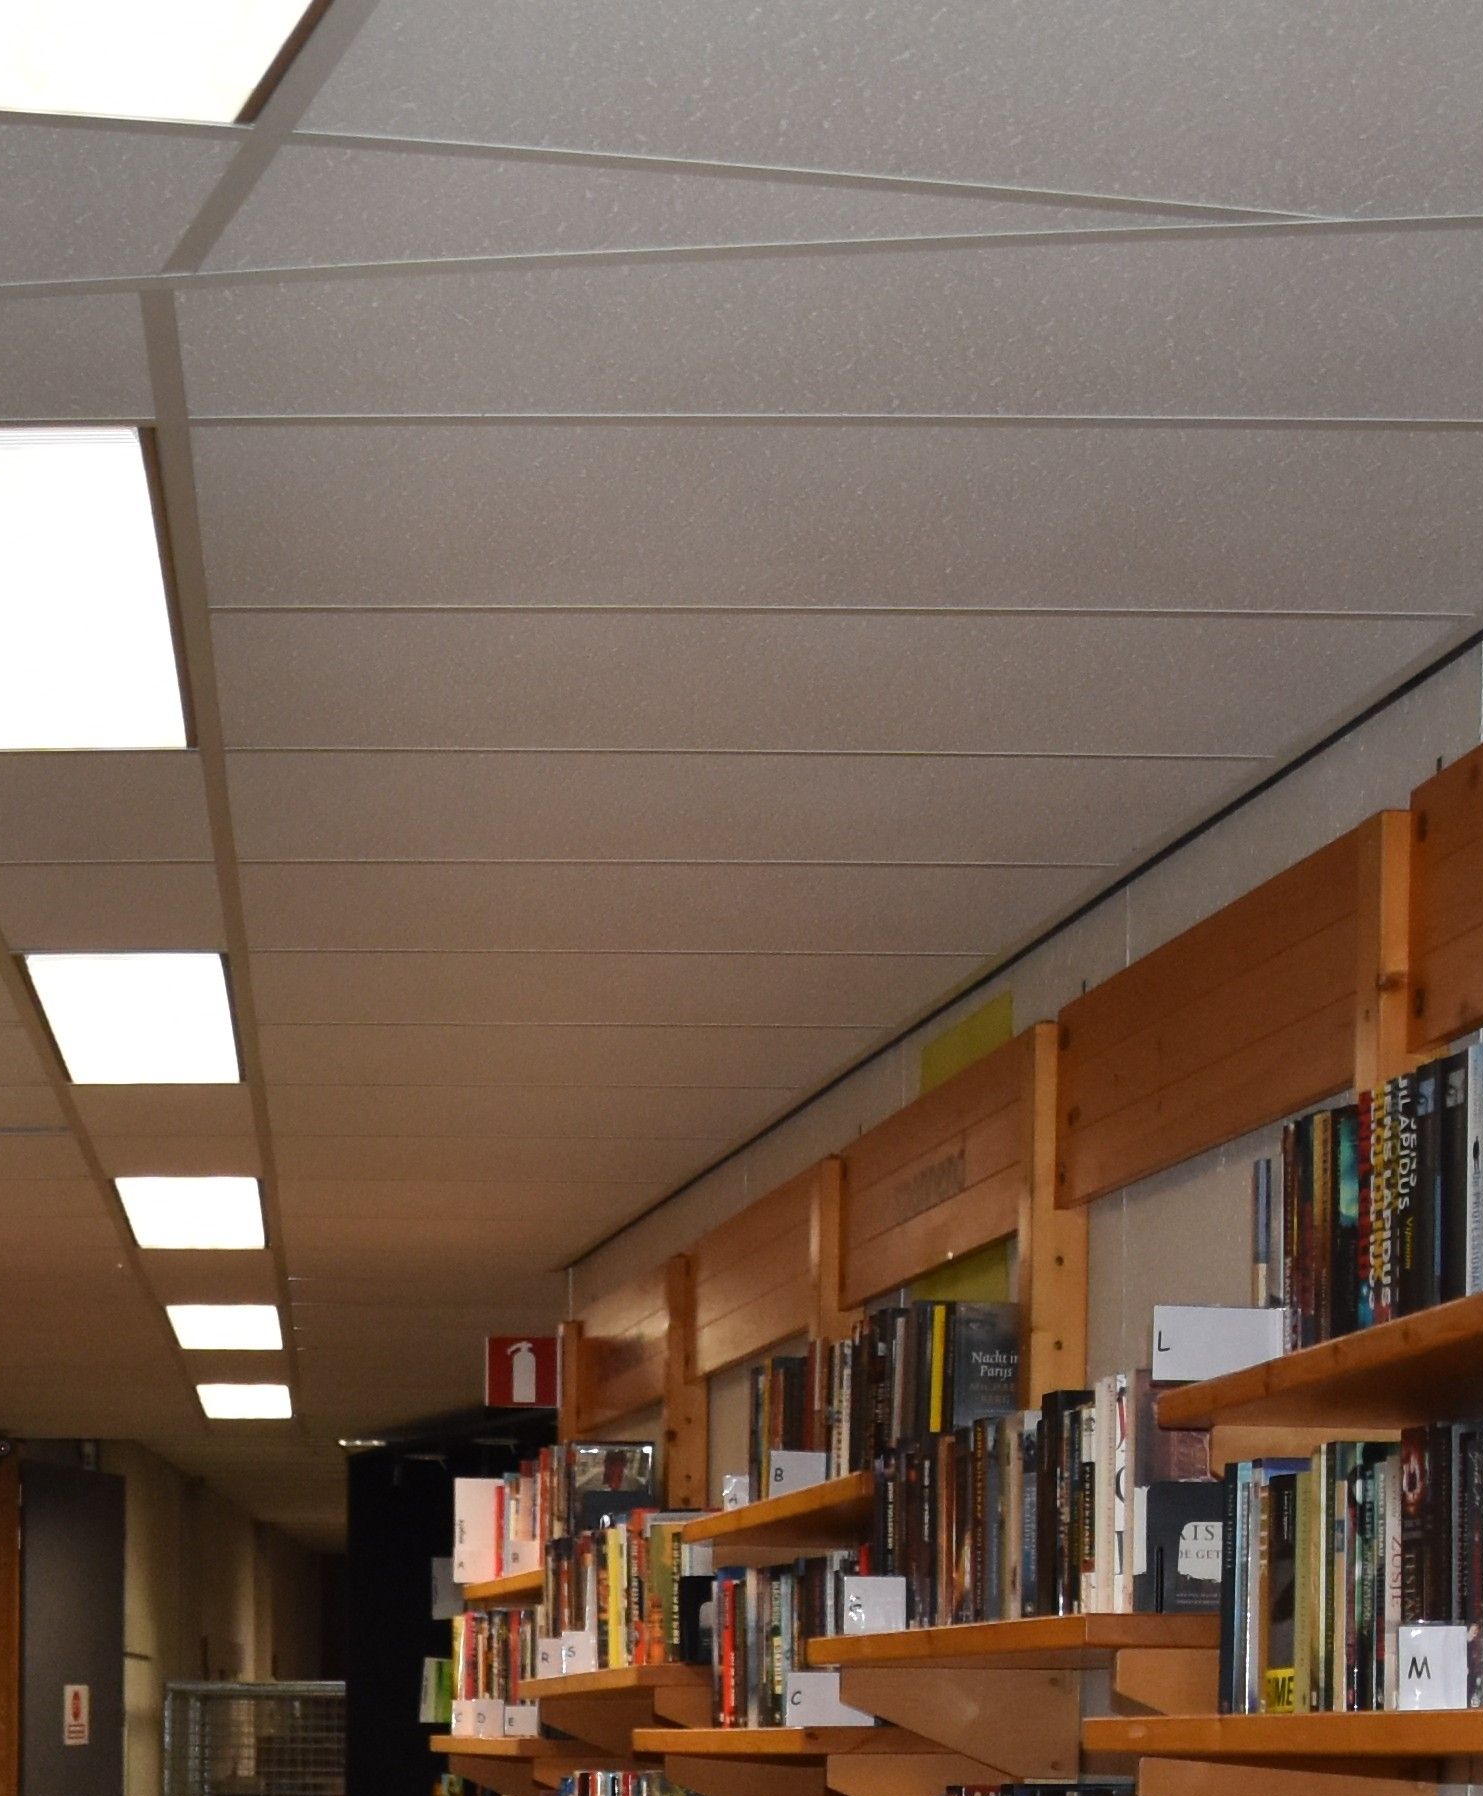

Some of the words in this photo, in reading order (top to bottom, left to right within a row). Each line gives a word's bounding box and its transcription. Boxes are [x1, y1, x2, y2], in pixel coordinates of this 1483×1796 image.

[1156, 1329, 1171, 1353] L
[971, 1351, 1001, 1365] Nacht
[980, 1365, 1013, 1380] Parijs
[773, 1465, 785, 1484] B
[1407, 1655, 1432, 1681] M
[790, 1689, 803, 1707] C
